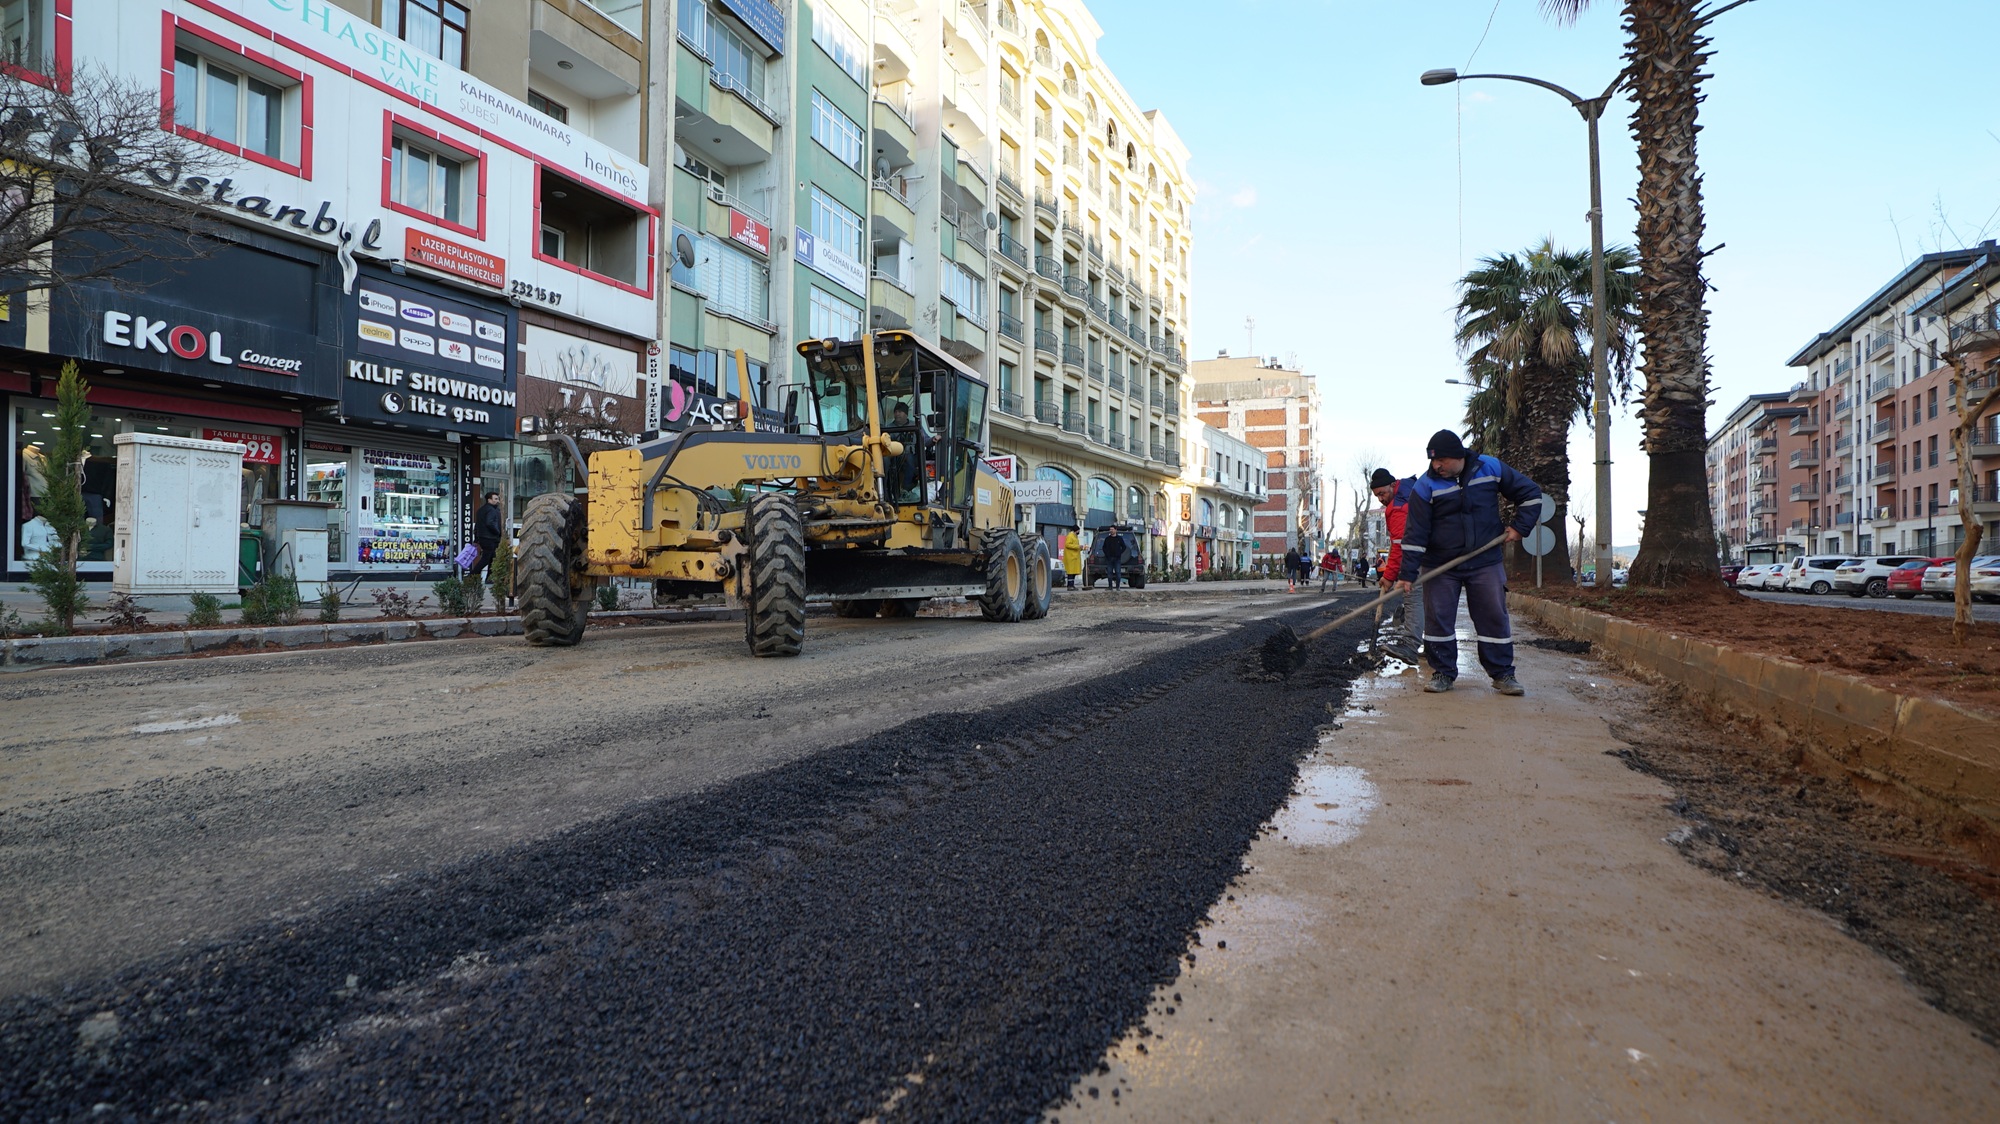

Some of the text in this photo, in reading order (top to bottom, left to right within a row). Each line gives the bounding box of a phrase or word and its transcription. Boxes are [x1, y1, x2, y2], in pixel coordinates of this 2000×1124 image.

[459, 98, 500, 126] ŞUBESİ
[459, 80, 572, 147] KAHRAMANMARAŞ
[584, 151, 638, 192] hennes
[420, 236, 496, 269] LAZER EPİLASYON &
[410, 246, 503, 285] ZAYIFLAMA MERKEZLERİ
[511, 280, 533, 298] 232
[534, 287, 547, 301] 15
[370, 299, 395, 312] iPhone
[405, 307, 431, 318] SAMSUNG
[103, 310, 233, 365] EKOL
[363, 328, 390, 338] realme
[486, 327, 502, 339] iPad
[239, 349, 302, 372] Concept
[477, 353, 502, 365] Infinix
[349, 359, 516, 408] KILIF SHOWROOM
[409, 395, 490, 424] ikiz gsm
[212, 430, 272, 442] TAKIM ELBİSE
[363, 448, 430, 463] PROFESYONEL
[363, 456, 433, 470] TEKNİK SERVİS
[742, 454, 802, 470] VOLVO
[372, 541, 438, 550] CEPTE NE VARSA
[384, 551, 427, 560] BİZDE VAR
